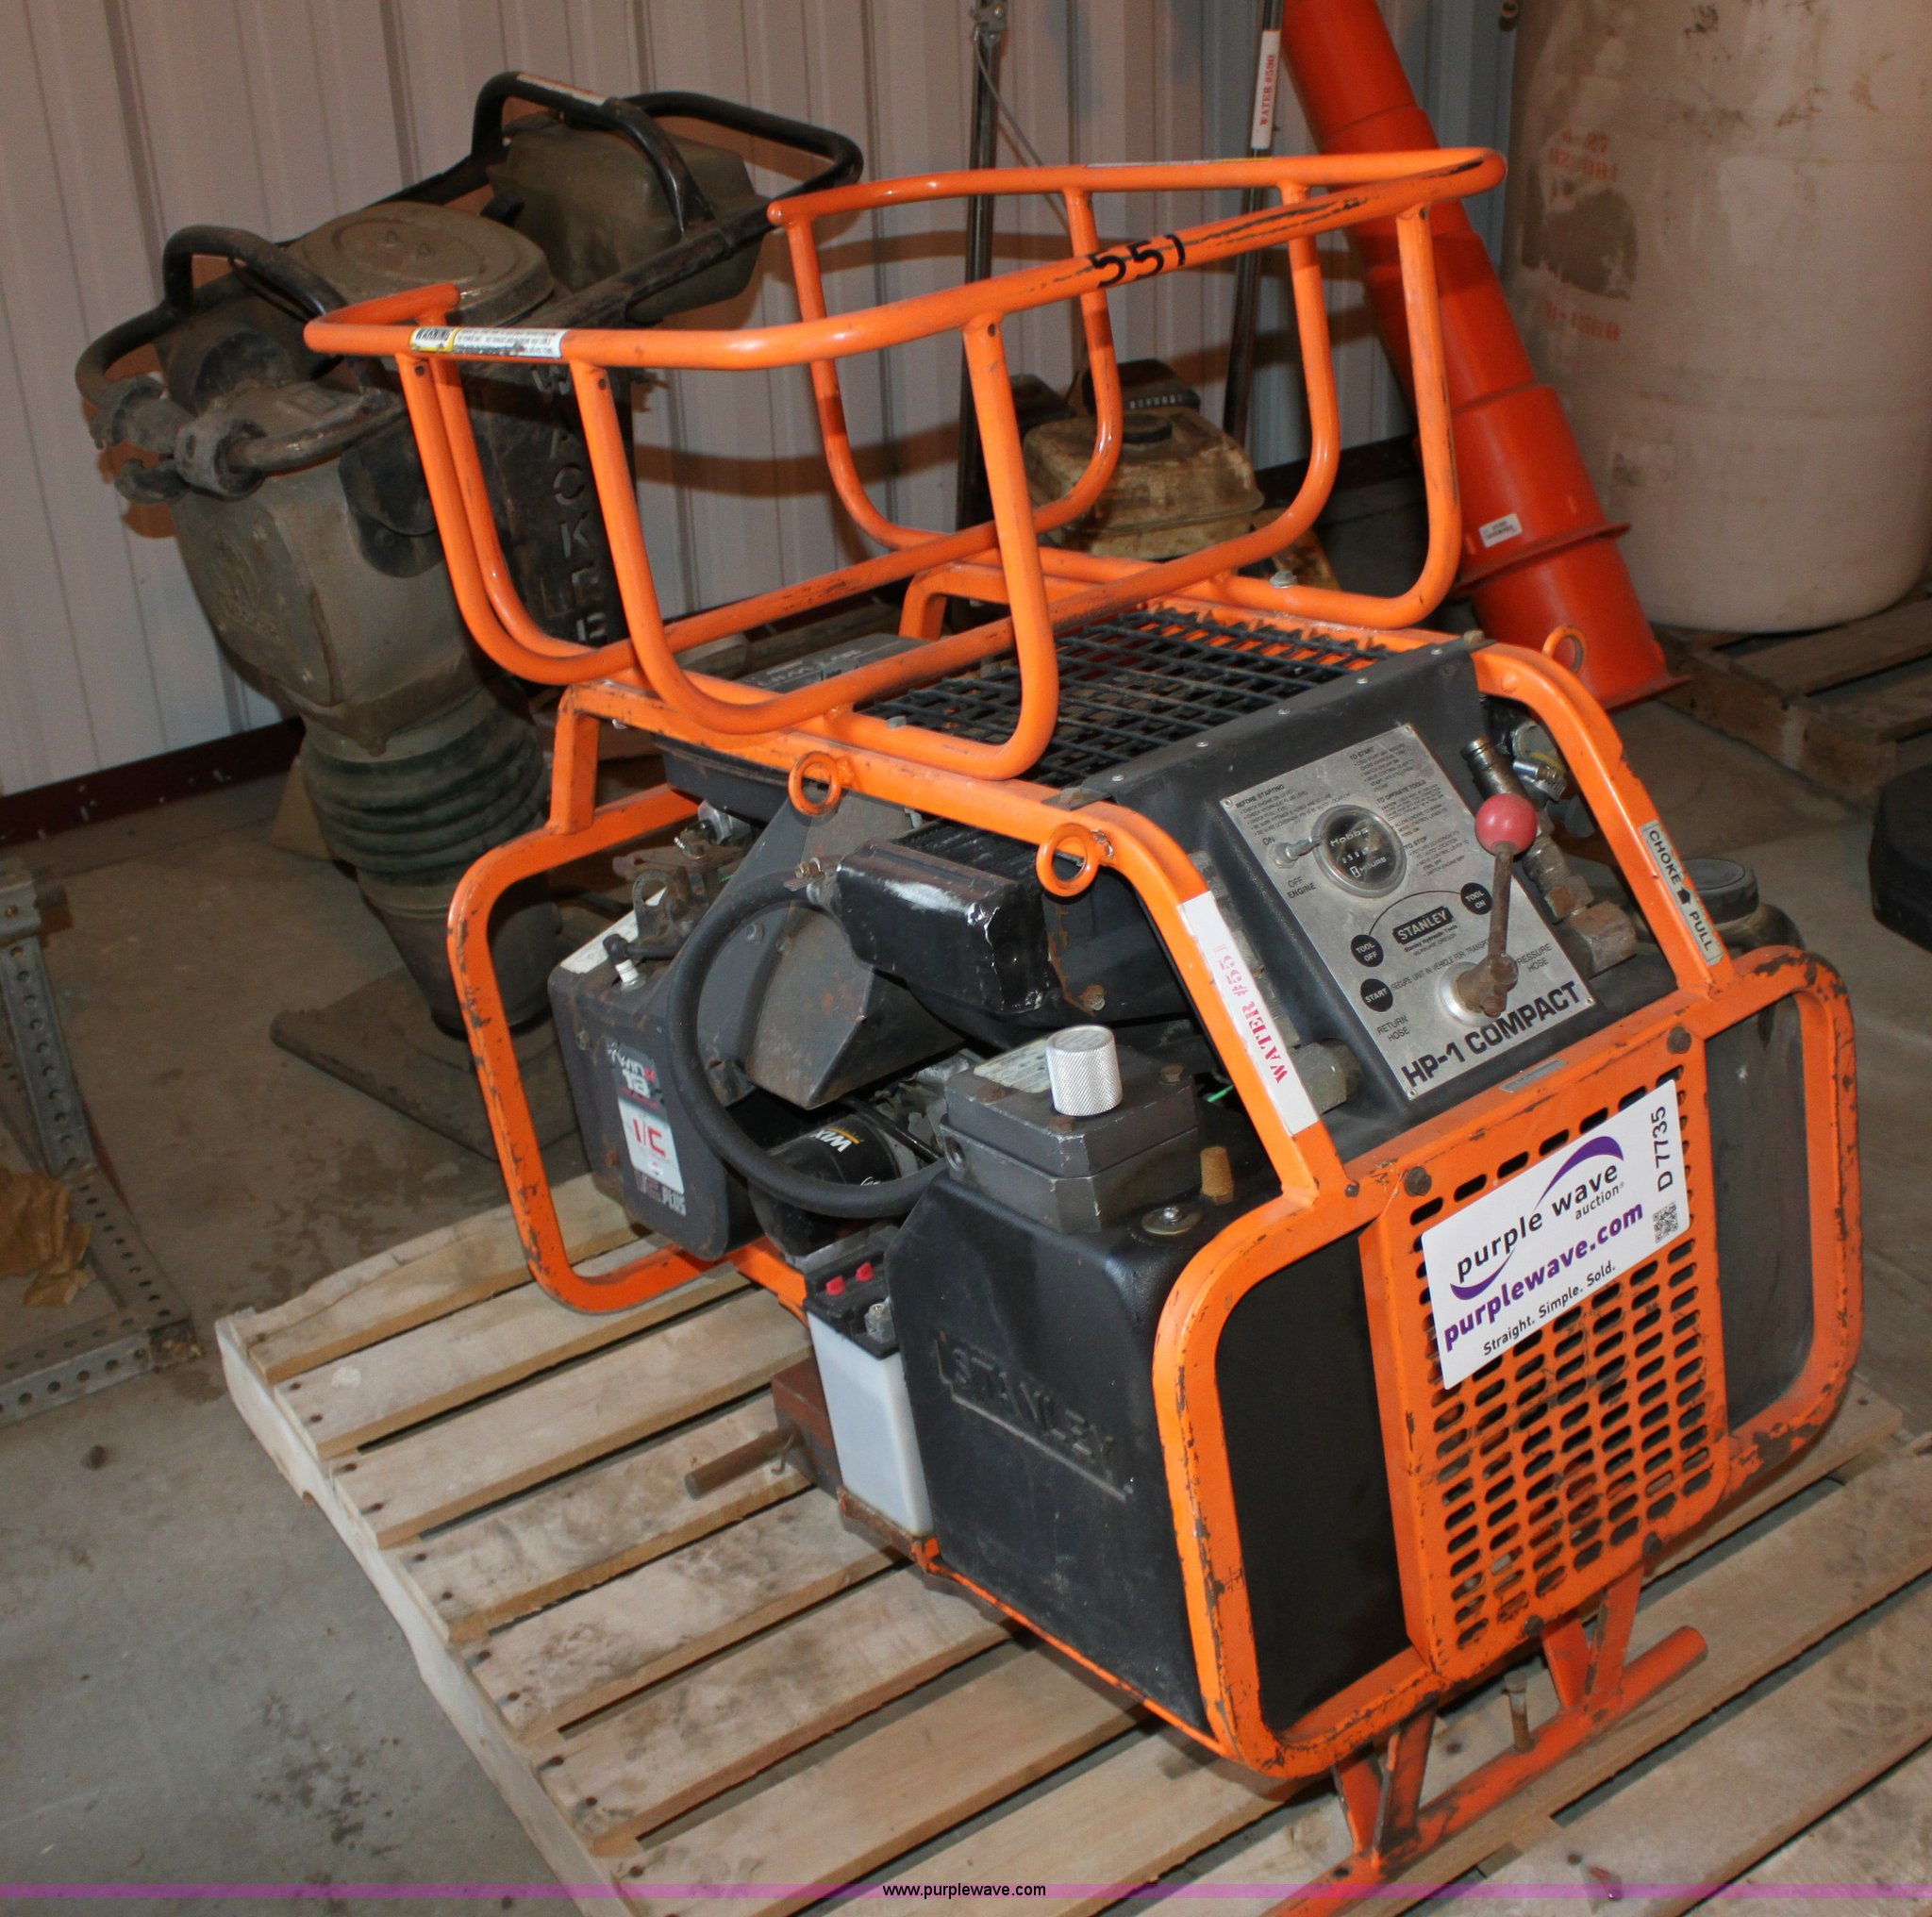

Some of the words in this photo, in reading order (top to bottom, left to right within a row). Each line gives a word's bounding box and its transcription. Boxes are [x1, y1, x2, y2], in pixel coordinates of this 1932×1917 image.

[1087, 233, 1186, 288] 551
[1261, 835, 1275, 845] ON
[1329, 827, 1369, 847] Hobbs
[1648, 829, 1682, 886] CHOKE
[1287, 875, 1304, 888] OFF
[1288, 882, 1316, 898] ENGINE
[1464, 889, 1485, 902] TOOL
[1474, 899, 1486, 908] ON
[1397, 909, 1448, 941] STANLEY
[1689, 910, 1713, 952] PULL
[1355, 941, 1375, 954] TOOL
[1362, 951, 1378, 961] OFF
[1516, 942, 1553, 965] RESSURE
[1525, 957, 1549, 972] HOSE
[1364, 987, 1389, 1003] START
[1375, 1014, 1408, 1035] RETURN
[1387, 1025, 1409, 1042] HOSE
[1401, 1042, 1465, 1087] HP-1
[1464, 981, 1580, 1054] COMPACT
[1242, 1000, 1289, 1084] WATER
[814, 1129, 853, 1153] WIX
[1457, 1211, 1543, 1283] purple
[1552, 1165, 1618, 1217] wave
[1443, 1203, 1643, 1353] purplewave.com
[1484, 1315, 1536, 1356] Straight.
[1539, 1288, 1583, 1320] Simple.
[1586, 1261, 1616, 1287] Sold.
